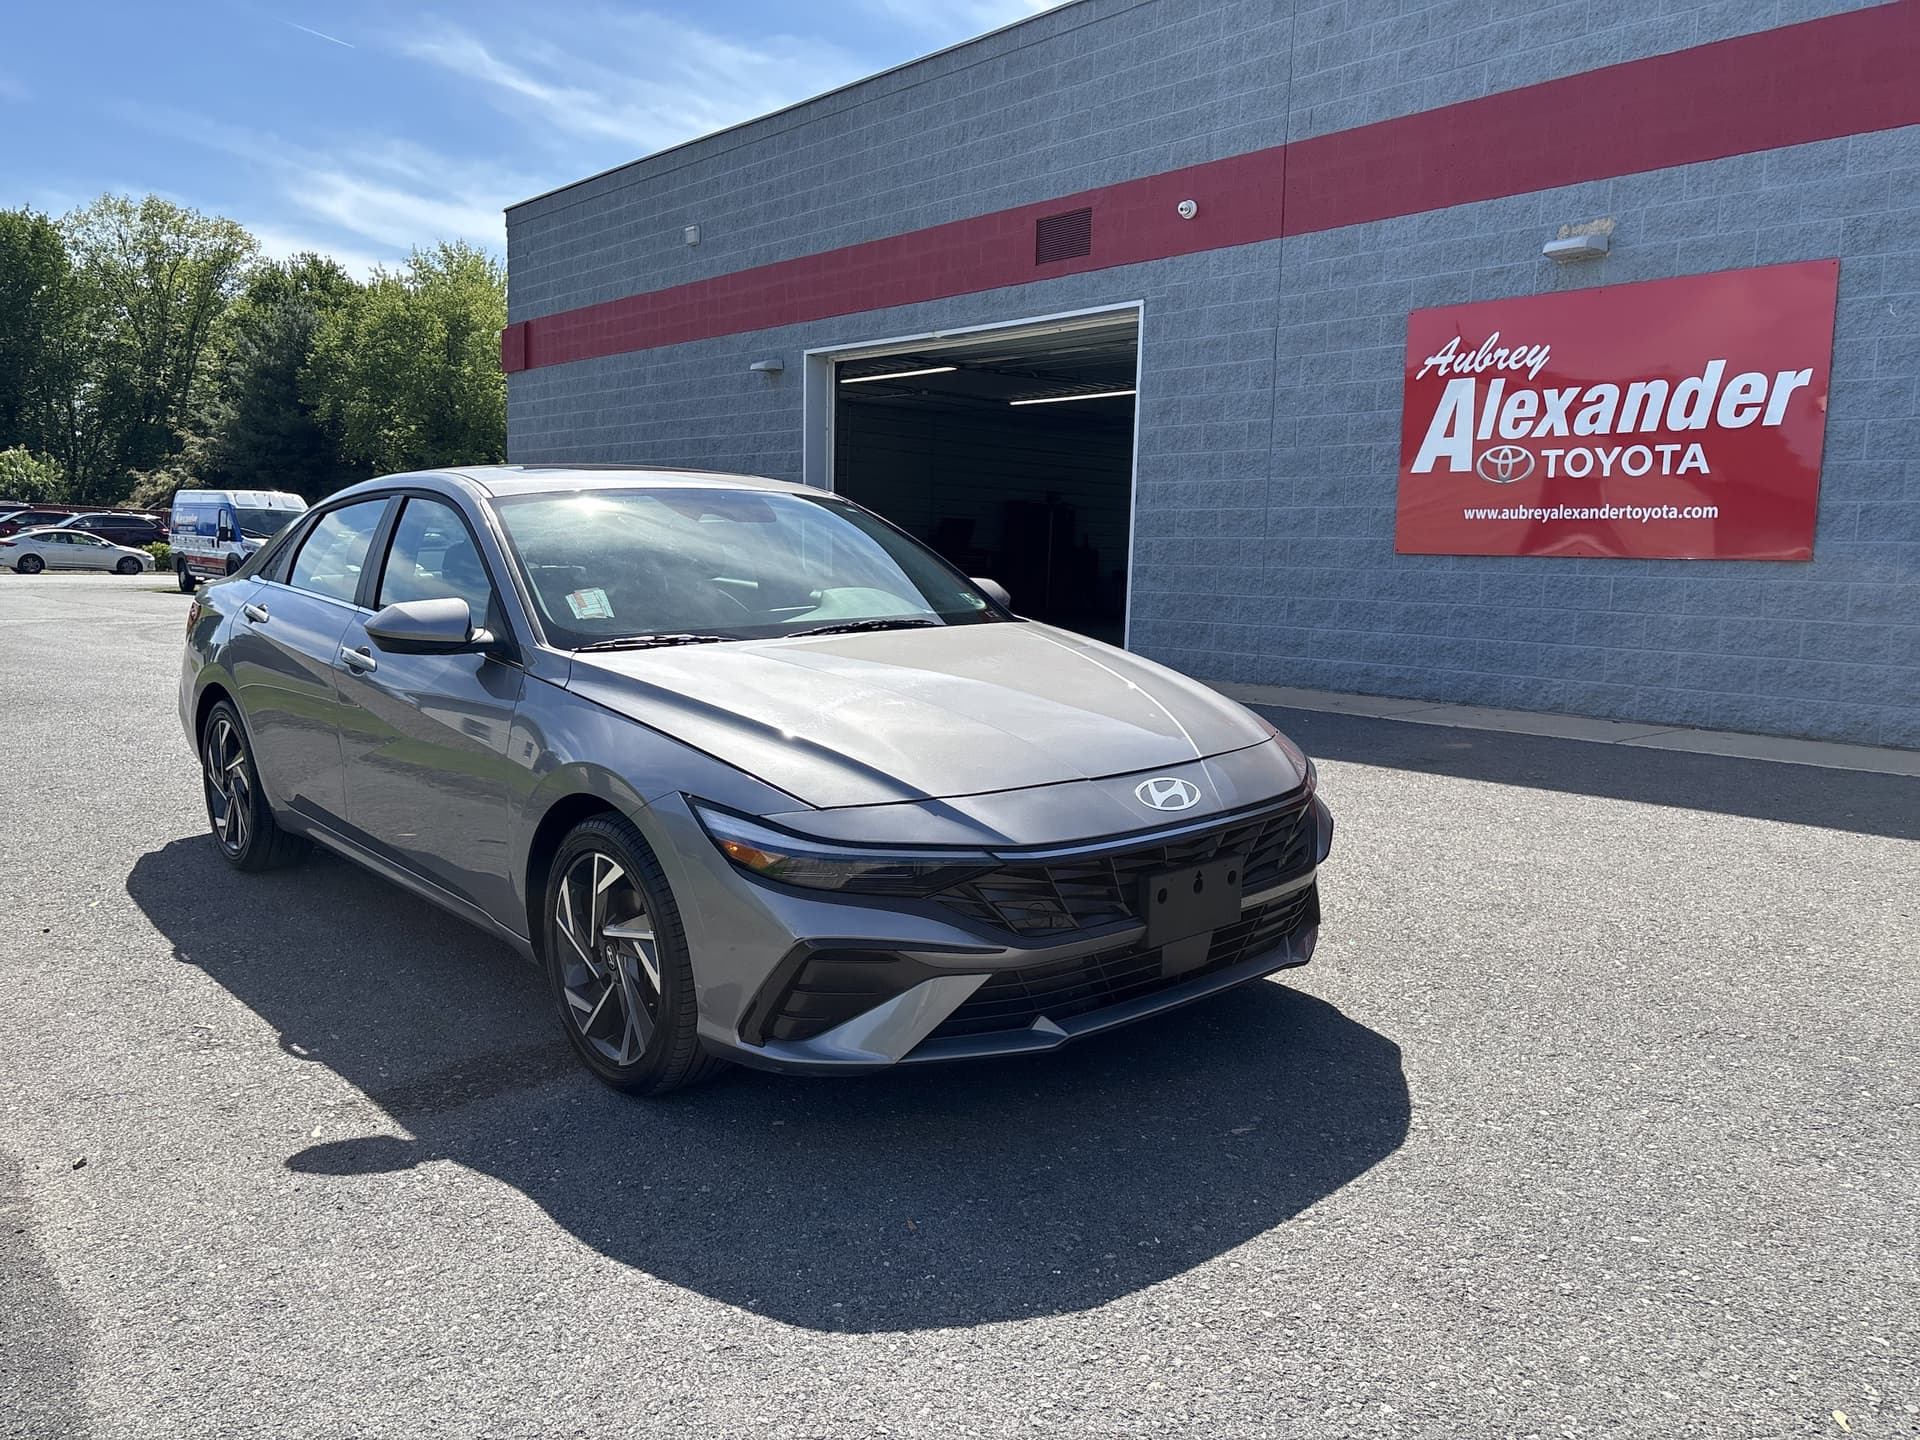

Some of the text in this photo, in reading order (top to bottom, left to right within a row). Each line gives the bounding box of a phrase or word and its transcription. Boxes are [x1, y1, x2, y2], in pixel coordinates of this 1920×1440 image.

[1415, 331, 1551, 381] Aubrey
[1410, 359, 1814, 474] Alexander
[1541, 443, 1711, 479] TOYOTA
[1464, 504, 1719, 523] www.aubreyalexandertoyota.com
